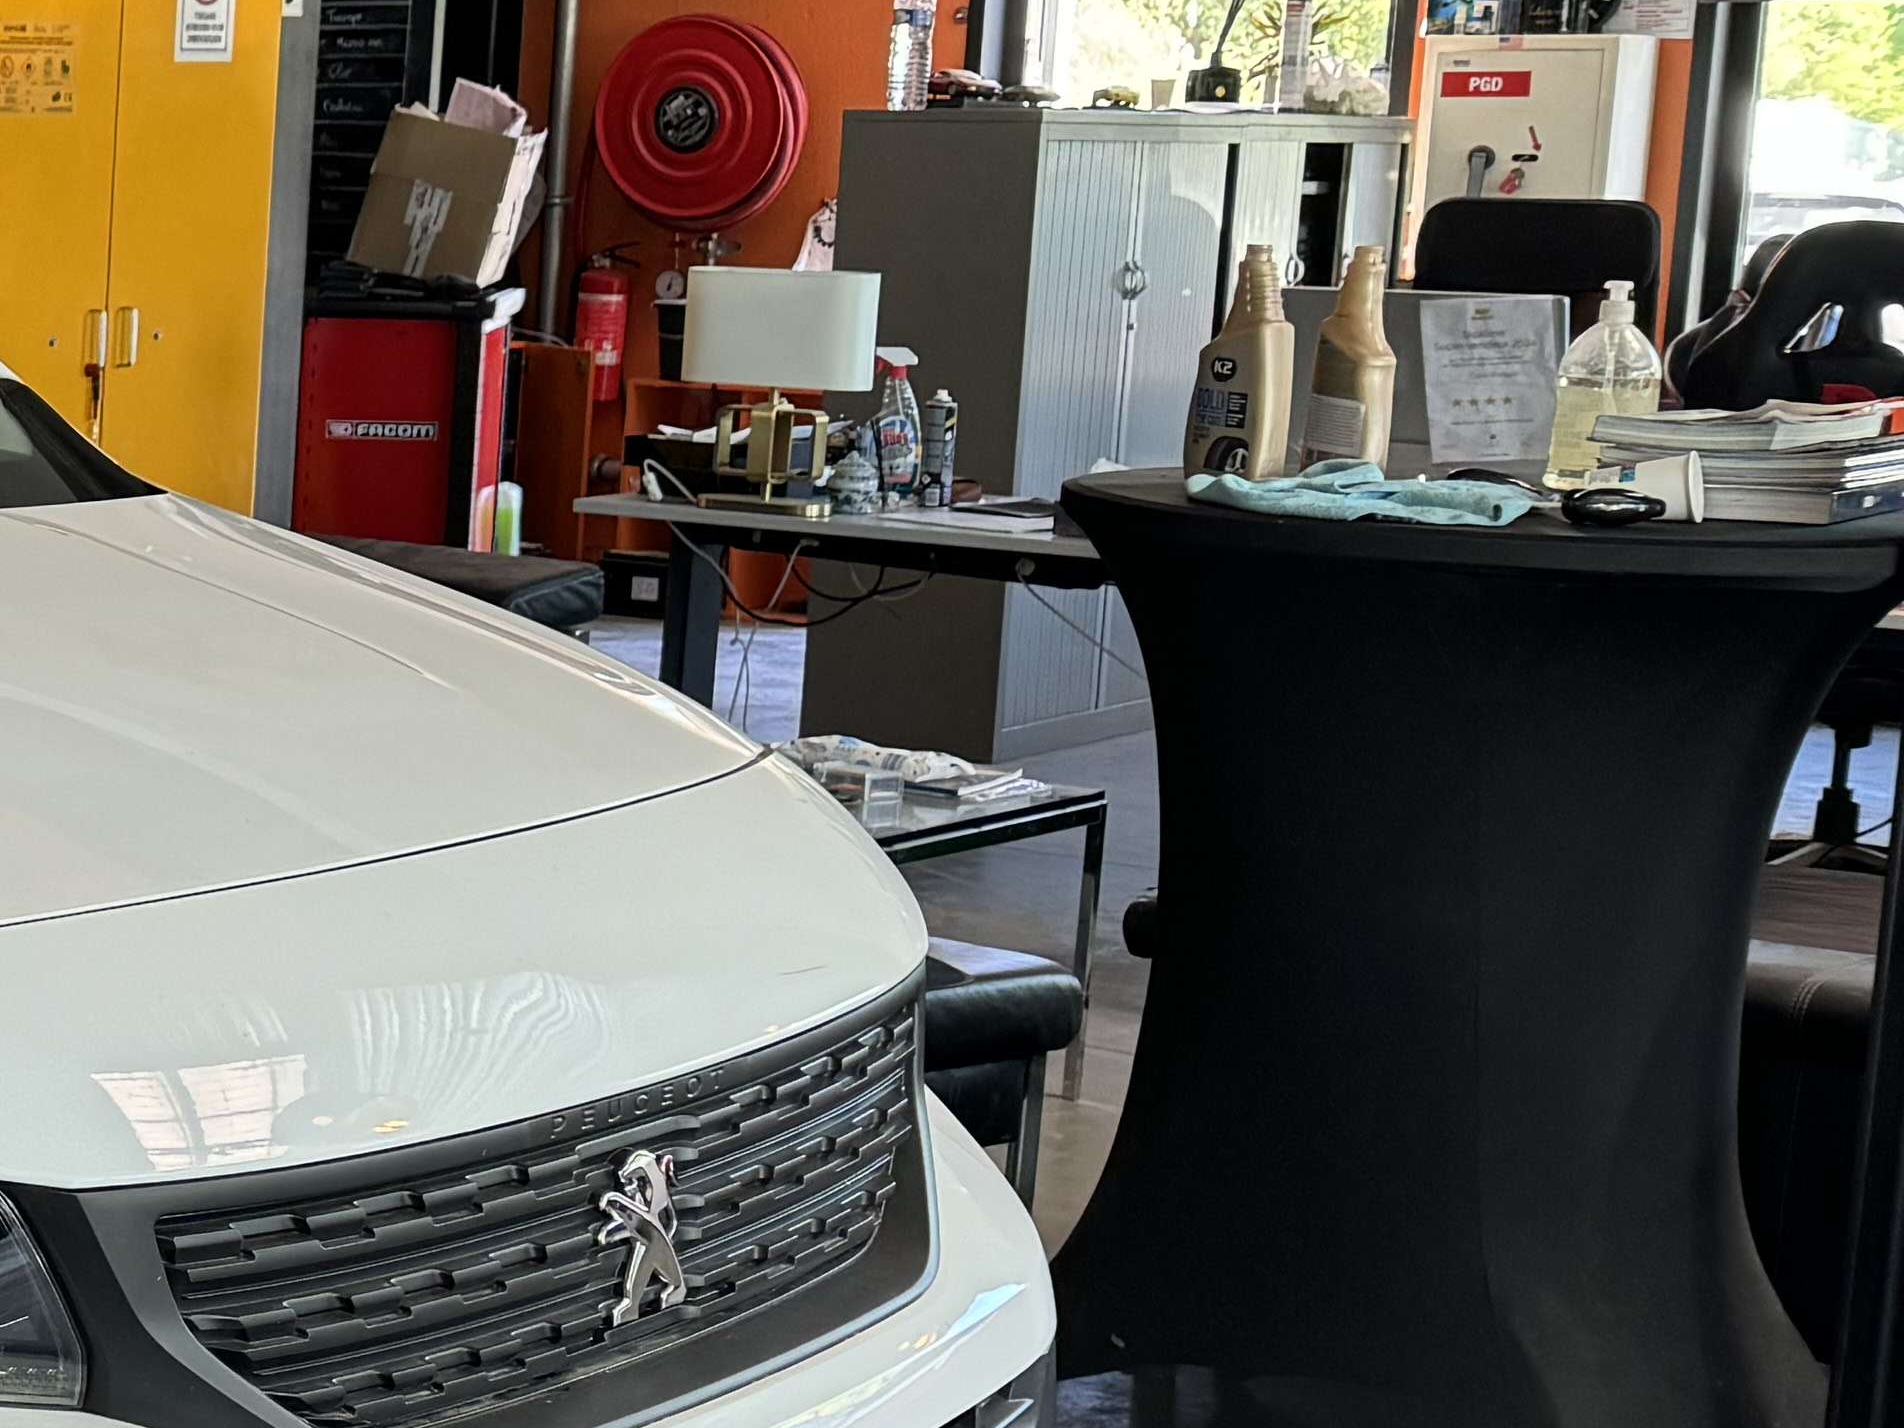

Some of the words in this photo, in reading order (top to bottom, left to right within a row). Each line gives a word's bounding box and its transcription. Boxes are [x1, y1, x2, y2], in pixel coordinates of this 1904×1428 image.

[1468, 76, 1504, 92] PGD
[1213, 359, 1233, 375] K2
[357, 423, 434, 438] FACOM
[550, 1068, 725, 1140] PEUGEOT
